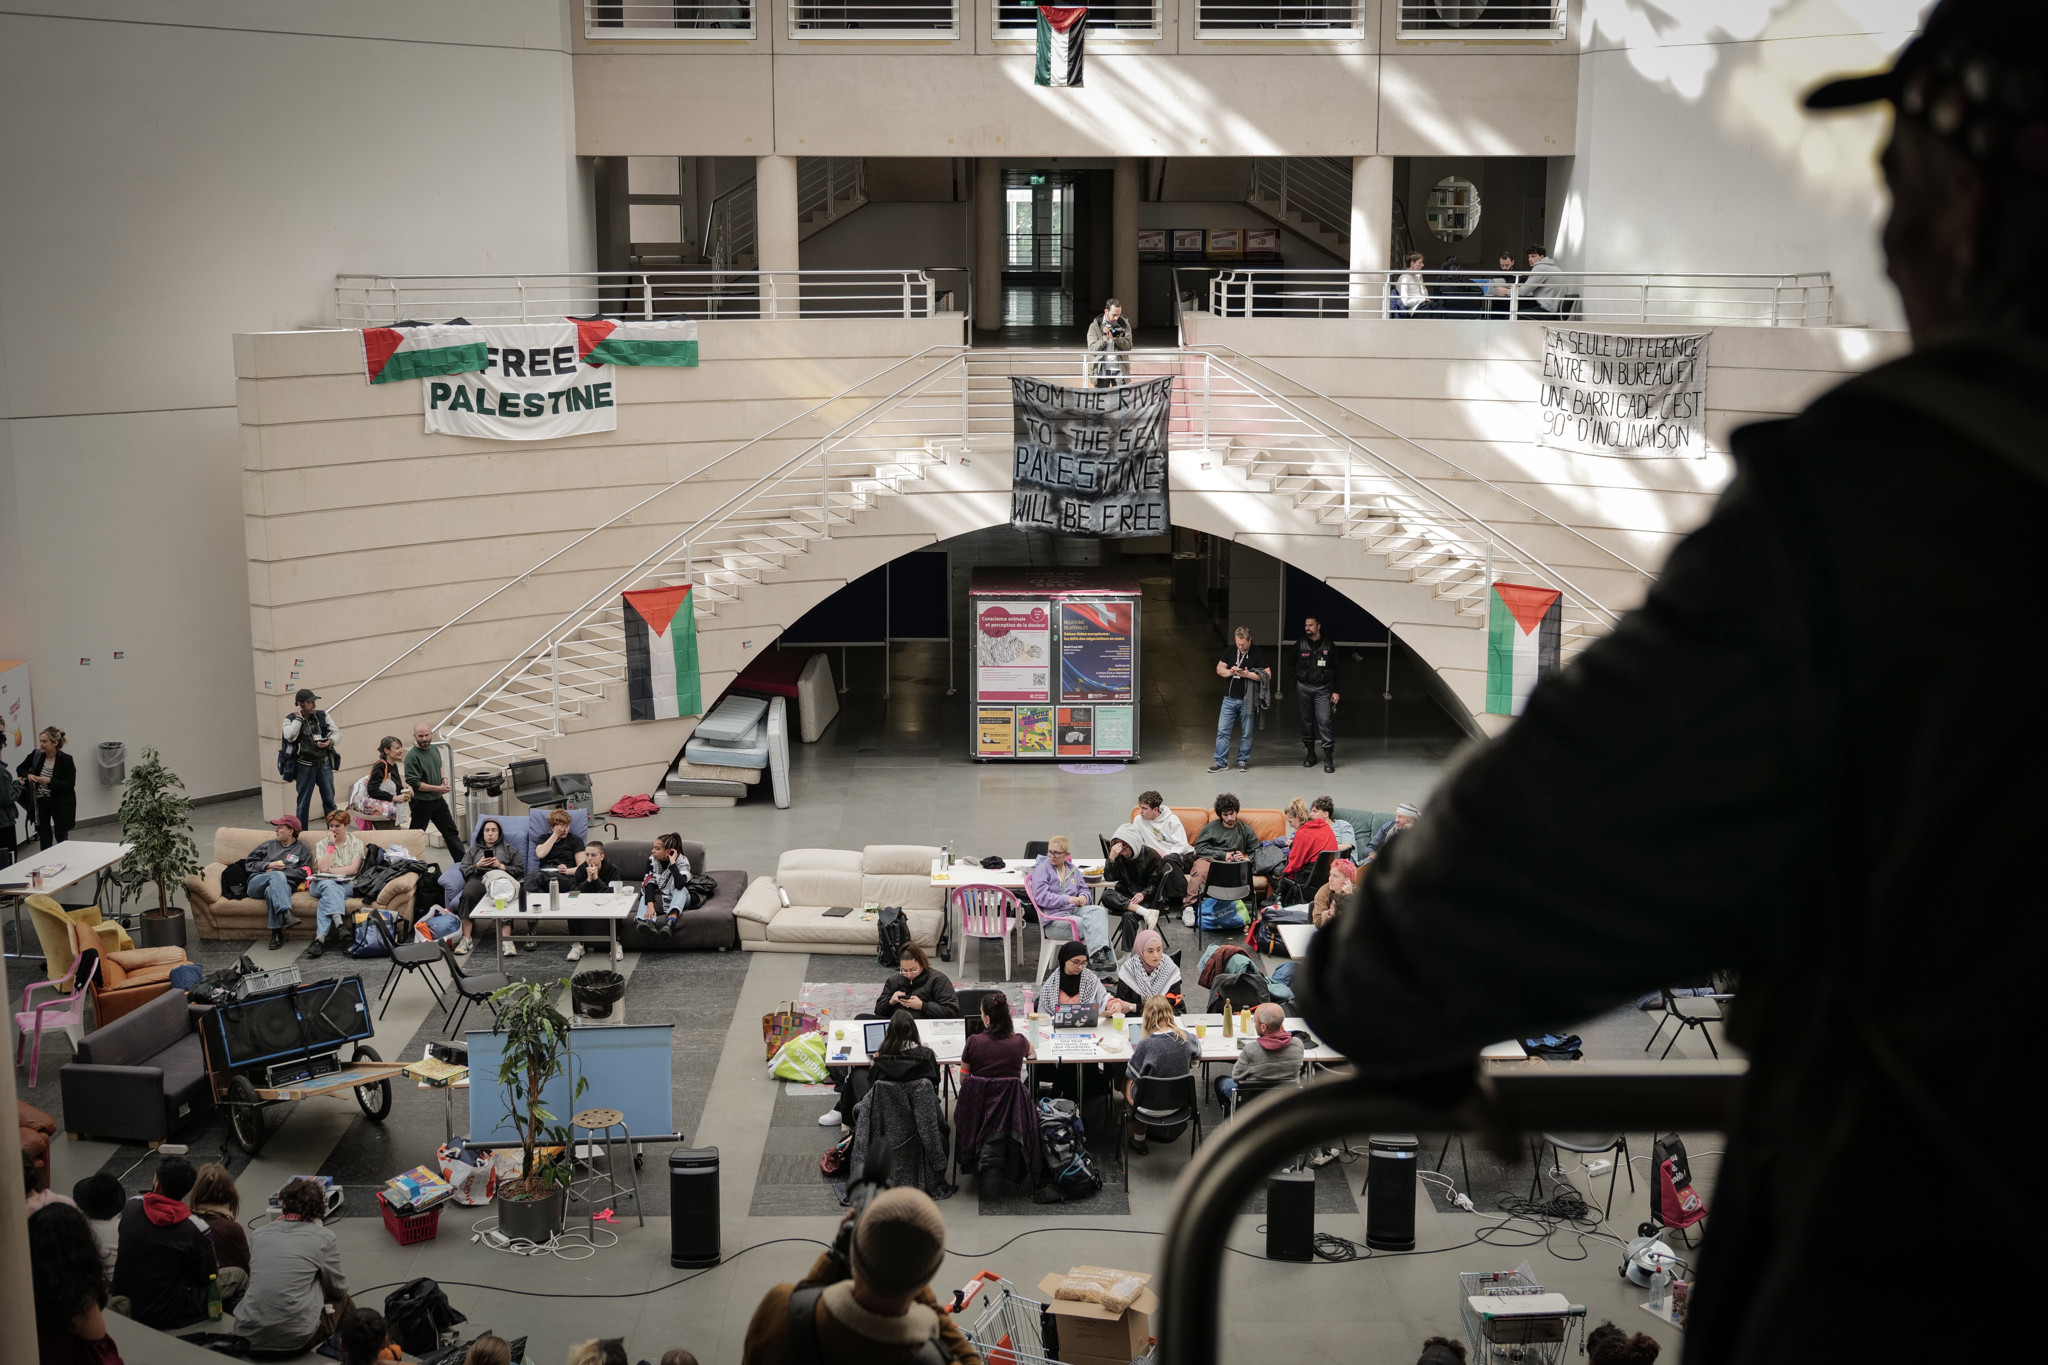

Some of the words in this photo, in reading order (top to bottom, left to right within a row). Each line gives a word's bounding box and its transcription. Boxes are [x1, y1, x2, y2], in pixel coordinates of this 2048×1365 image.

[1547, 330, 1563, 351] LA
[1569, 331, 1611, 357] SEULE
[479, 346, 578, 377] FREE
[1543, 353, 1588, 383] ENTRE
[1592, 361, 1613, 385] UN
[1618, 362, 1674, 386] BUREAU
[1677, 358, 1697, 383] ET
[430, 382, 614, 418] PALESTINE
[1013, 378, 1065, 408] FROM
[1075, 391, 1108, 411] THE
[1118, 377, 1172, 411] RIVER
[1540, 383, 1570, 412] UNE
[1660, 391, 1703, 420] C'EST
[1026, 417, 1052, 446] TO
[1070, 428, 1109, 451] THE
[1118, 421, 1159, 452] SEA
[1577, 416, 1690, 449] D'INCLINAISON
[1015, 446, 1163, 491] PALESTINE
[1013, 492, 1054, 525] WILL
[1063, 501, 1091, 531] BE
[1102, 503, 1161, 532] FREE
[794, 1048, 827, 1080] MIGROS
